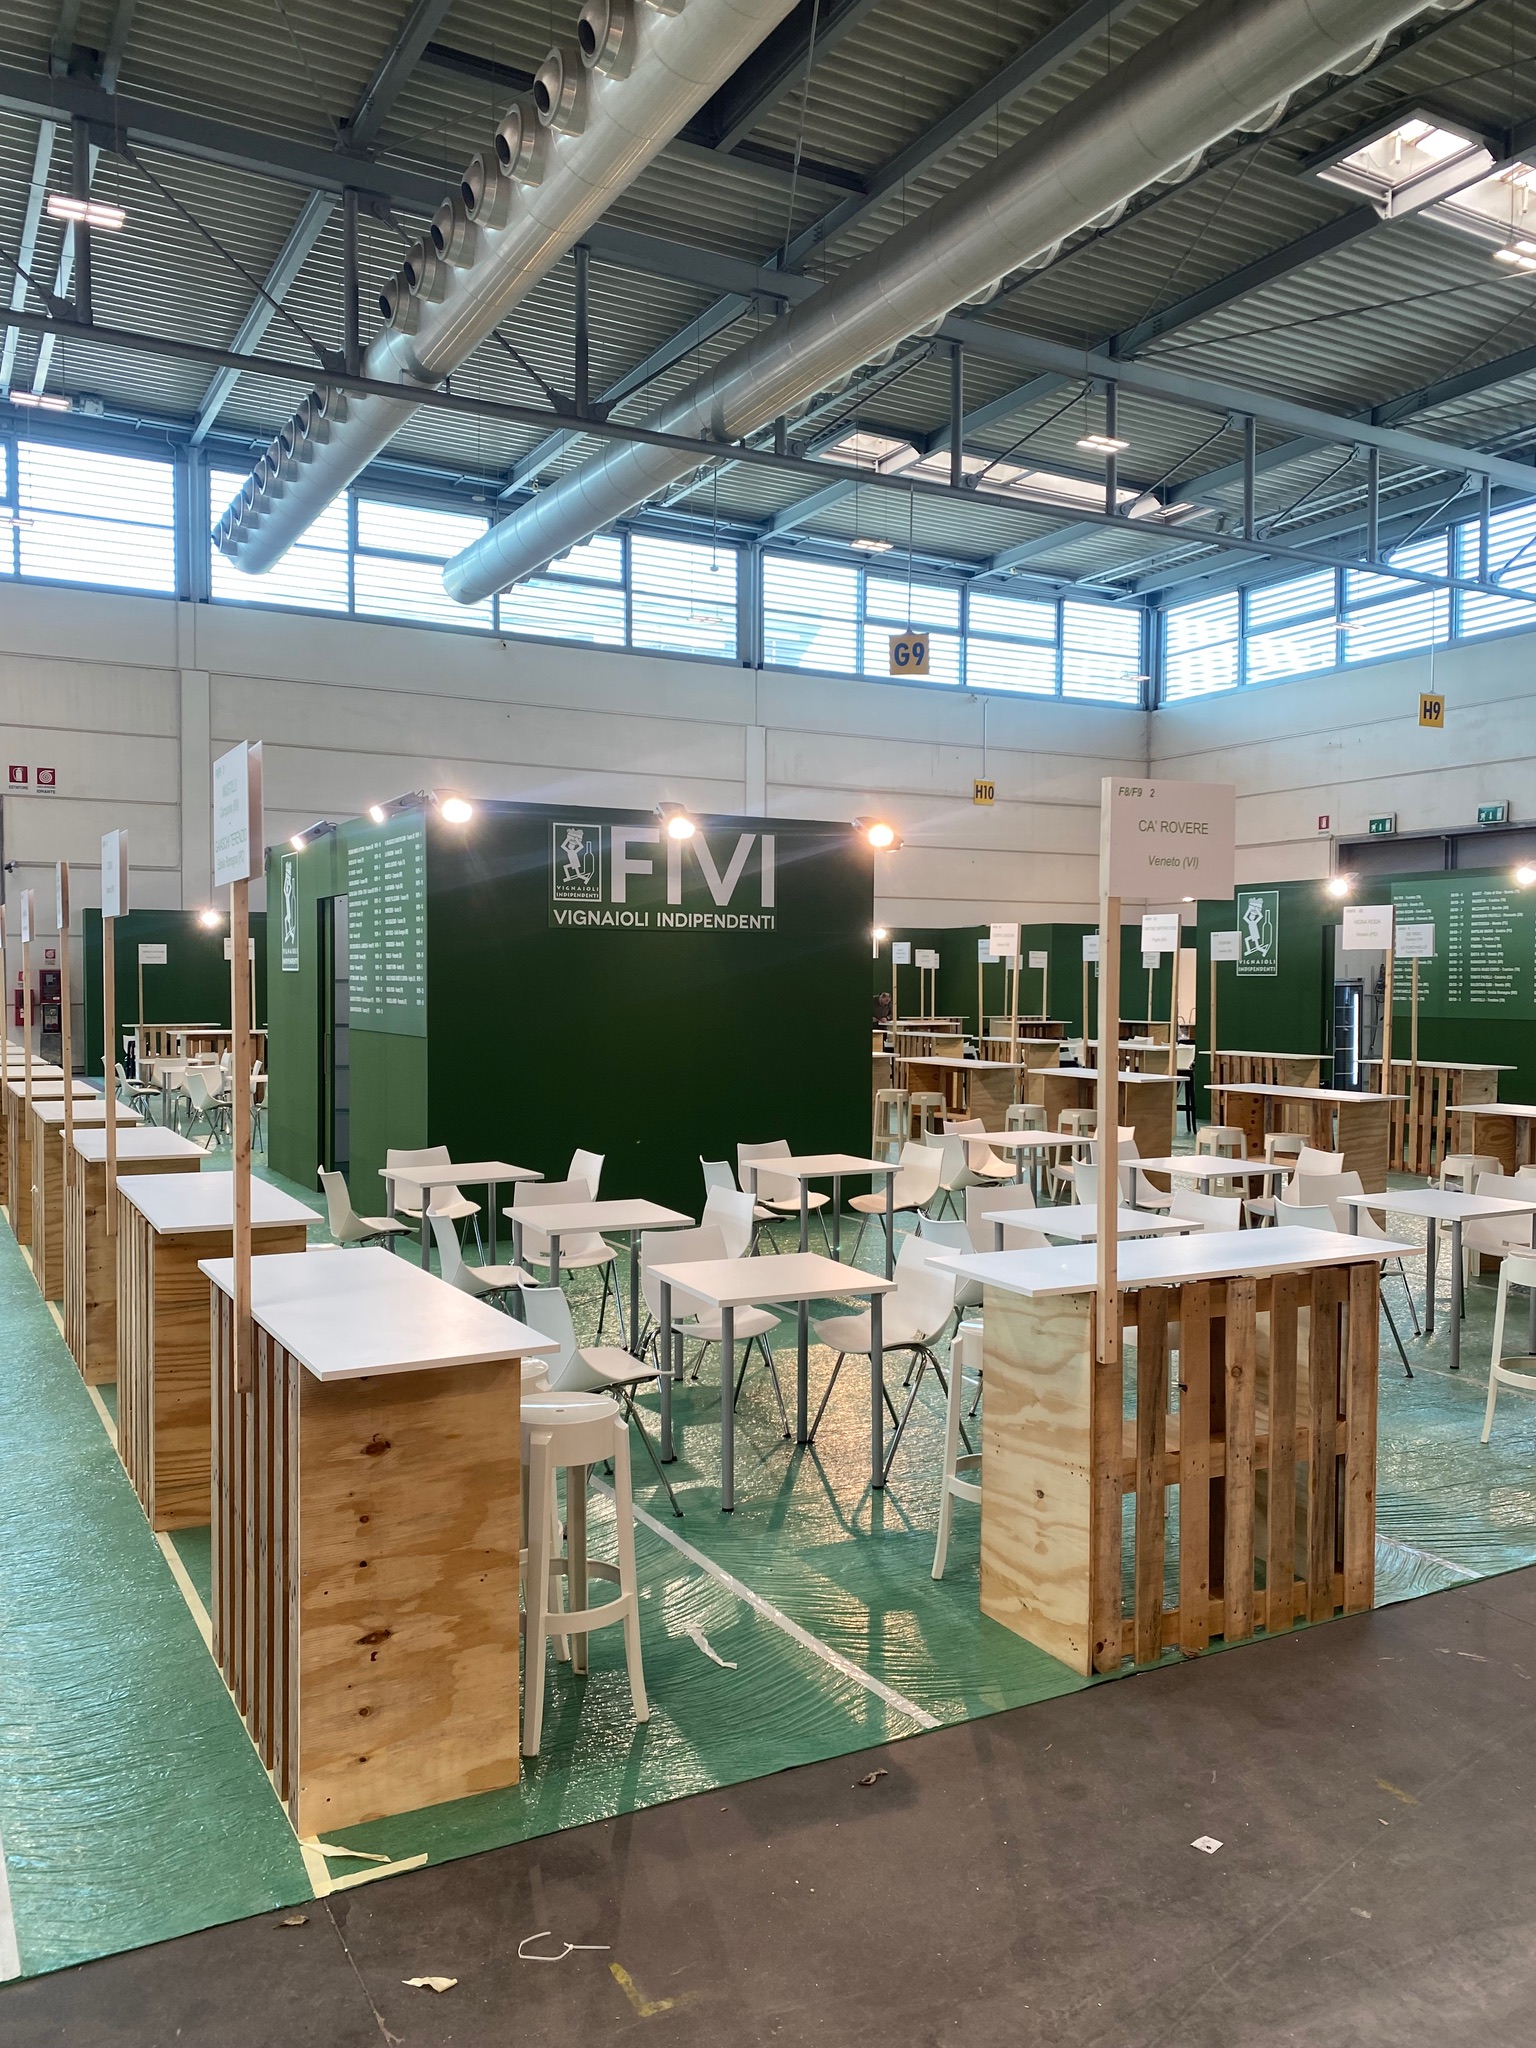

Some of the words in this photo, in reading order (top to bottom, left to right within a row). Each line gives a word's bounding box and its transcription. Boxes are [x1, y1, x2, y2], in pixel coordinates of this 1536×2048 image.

[894, 642, 924, 666] G9
[1423, 700, 1441, 720] H9
[975, 785, 994, 800] H10
[1118, 786, 1143, 797] F8/F9
[1149, 788, 1156, 798] 2
[1138, 819, 1158, 832] CA'
[1160, 820, 1209, 835] ROVERE
[610, 825, 775, 907] FIVI
[1148, 855, 1181, 867] Veneto
[1183, 856, 1199, 870] (VI)
[553, 909, 648, 926] VIGNAIOLI
[657, 912, 775, 929] INDIPENDENTI
